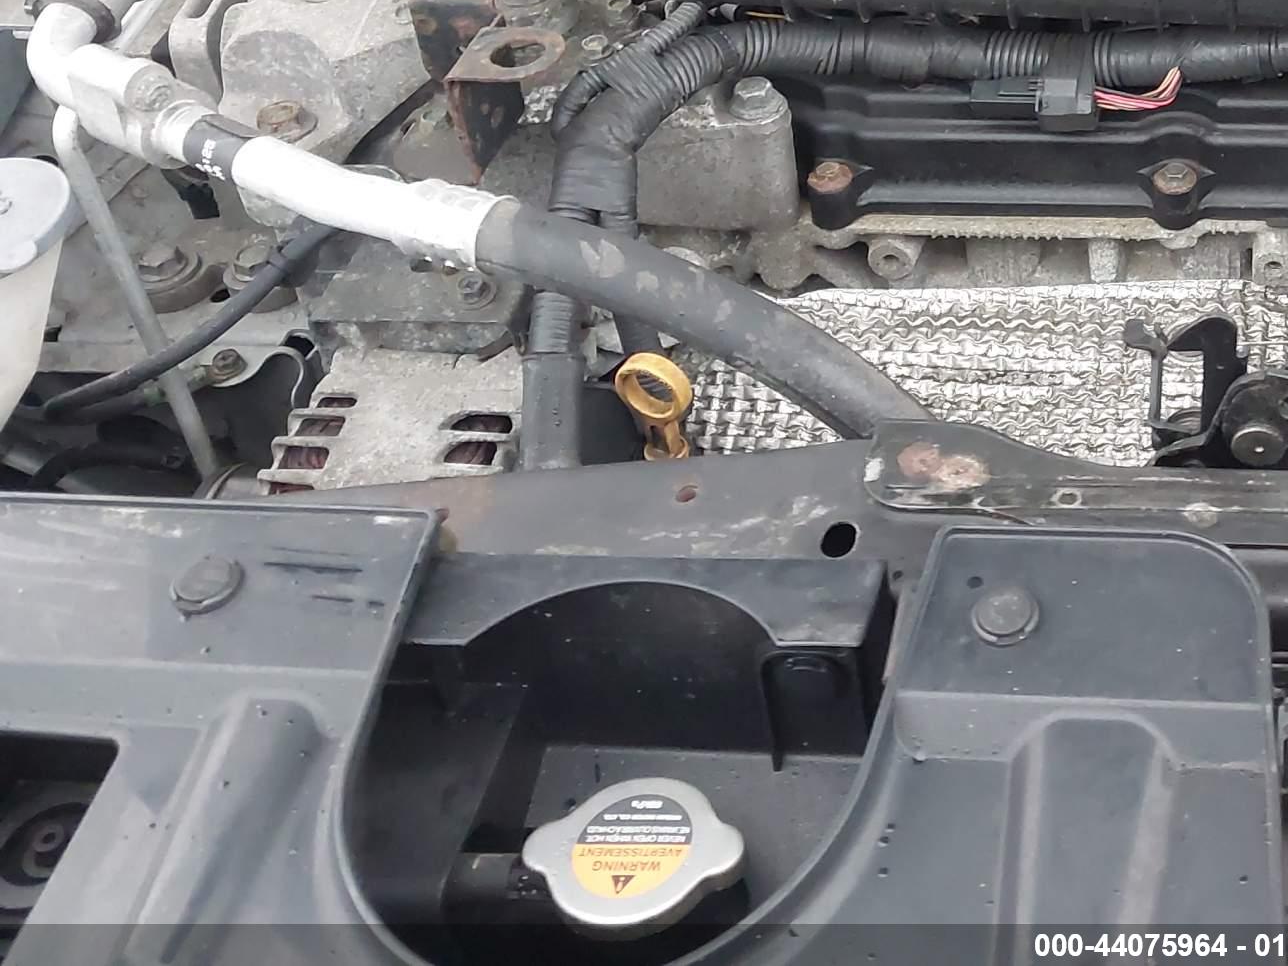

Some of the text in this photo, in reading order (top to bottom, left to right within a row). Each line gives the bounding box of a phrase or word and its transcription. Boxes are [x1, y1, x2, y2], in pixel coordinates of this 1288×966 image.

[633, 835, 657, 843] OPEN
[577, 847, 683, 857] AVERTISSEMENT
[592, 861, 662, 871] WARNING
